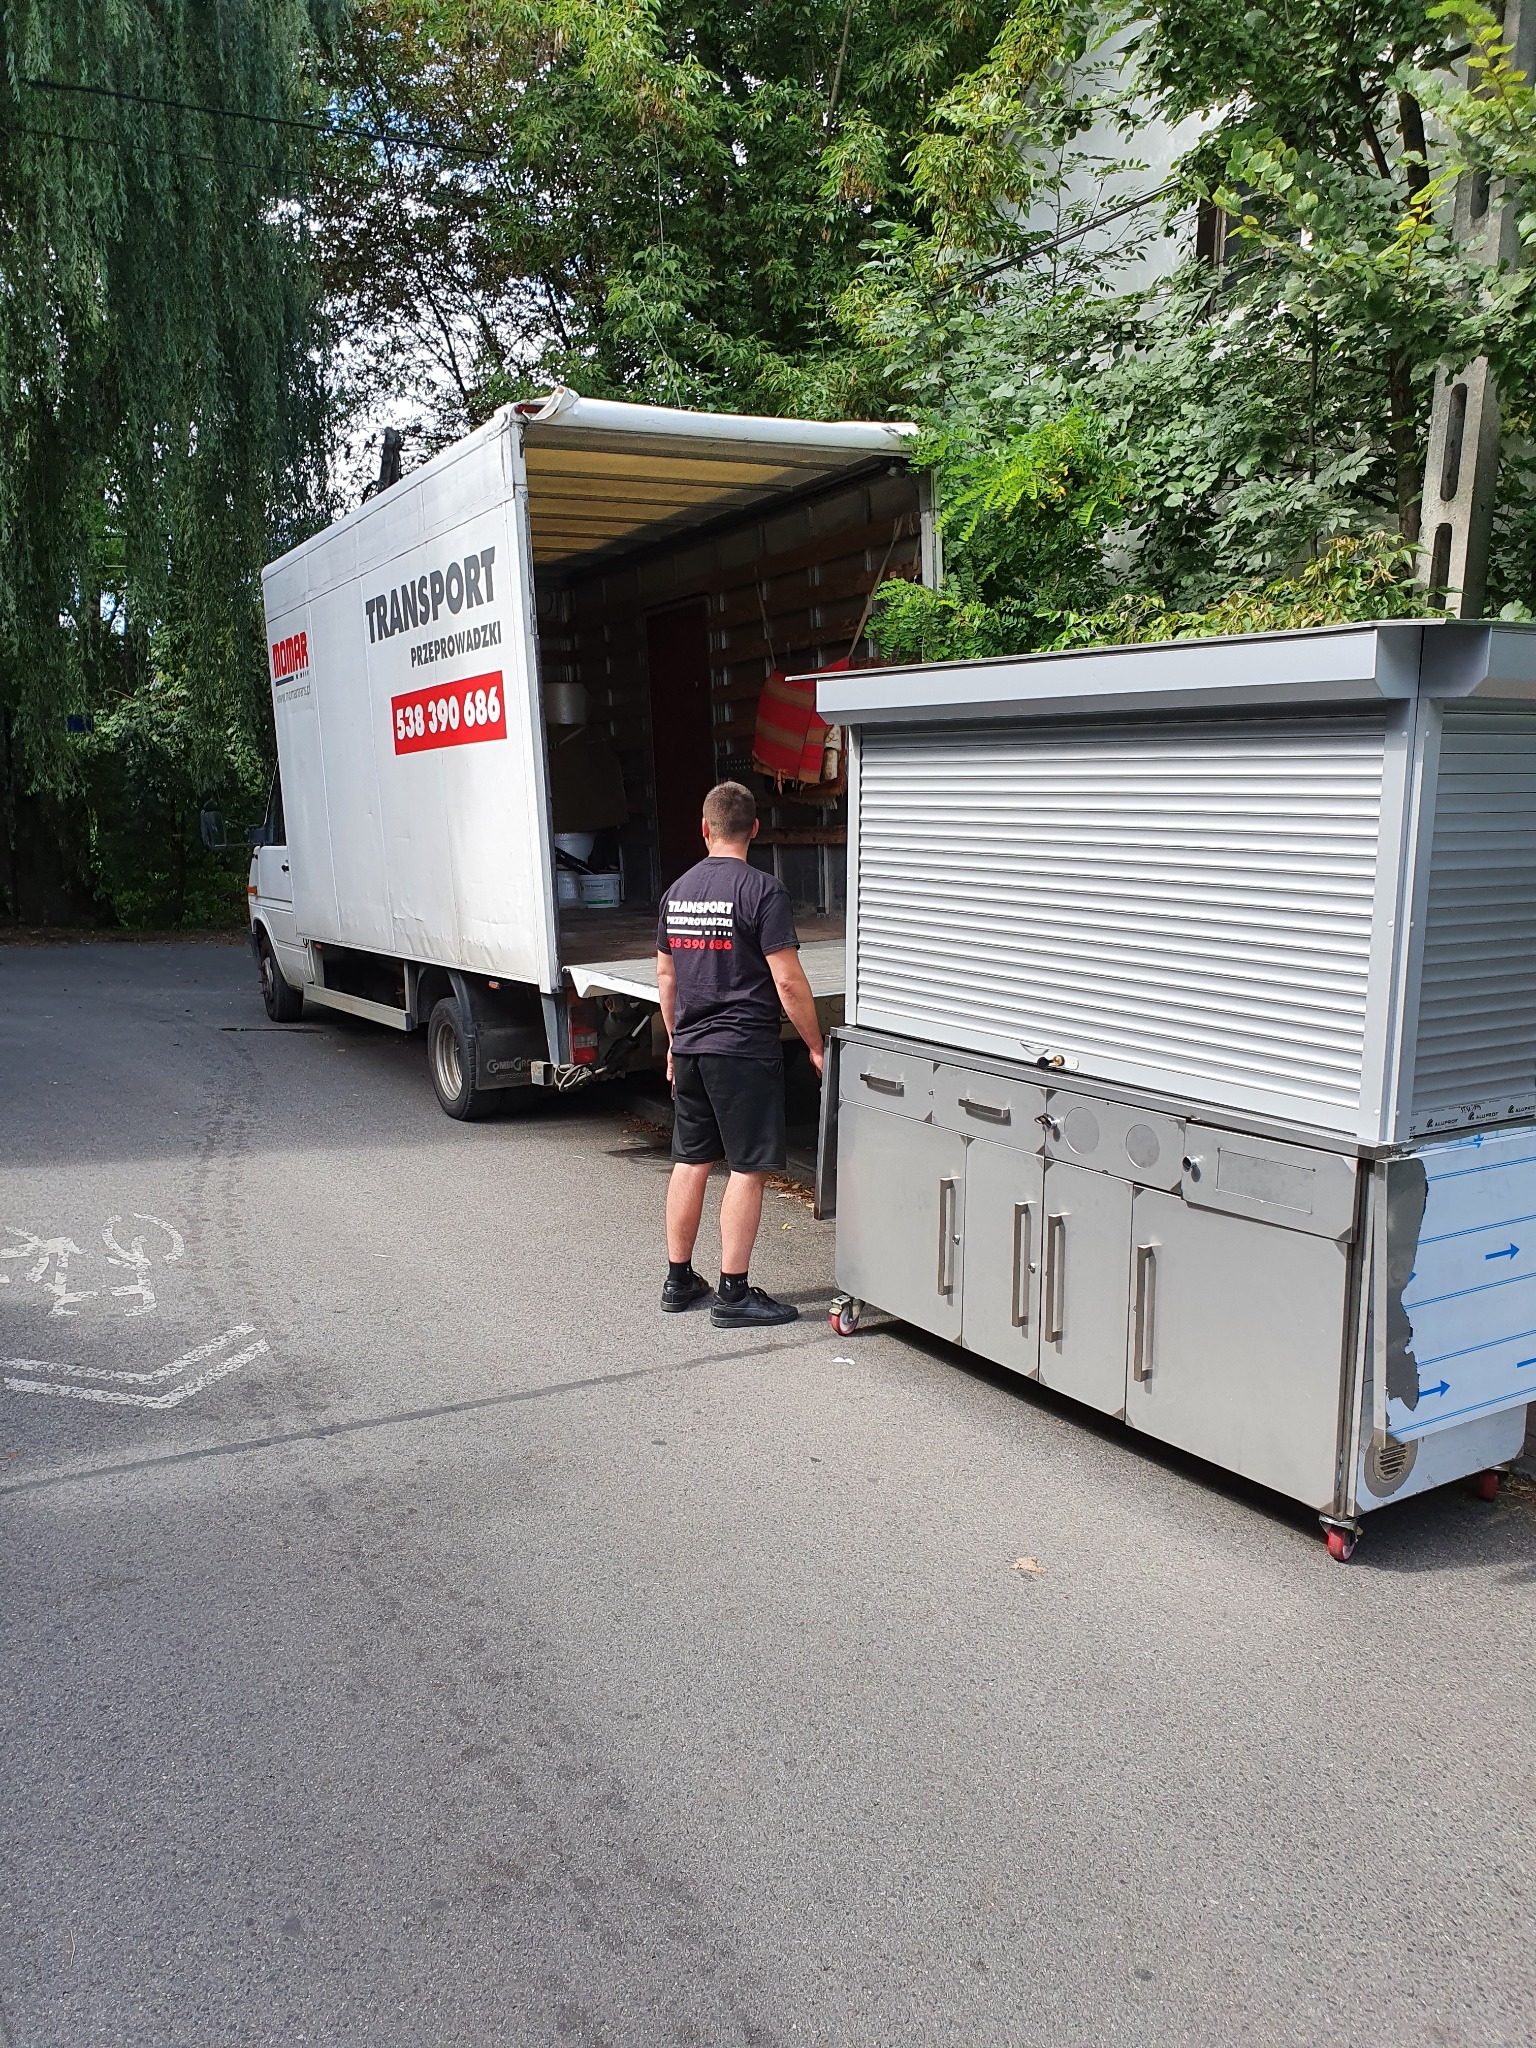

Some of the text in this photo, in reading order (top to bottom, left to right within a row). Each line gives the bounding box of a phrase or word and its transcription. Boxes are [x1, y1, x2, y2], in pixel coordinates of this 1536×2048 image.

[365, 545, 496, 645] TRANSPORT
[272, 631, 309, 679] MOMAR
[410, 620, 502, 668] PRZEPROWADZKI
[396, 686, 501, 741] 538 390 686
[668, 901, 733, 914] TRANSPORT
[669, 937, 732, 950] 38 390 686
